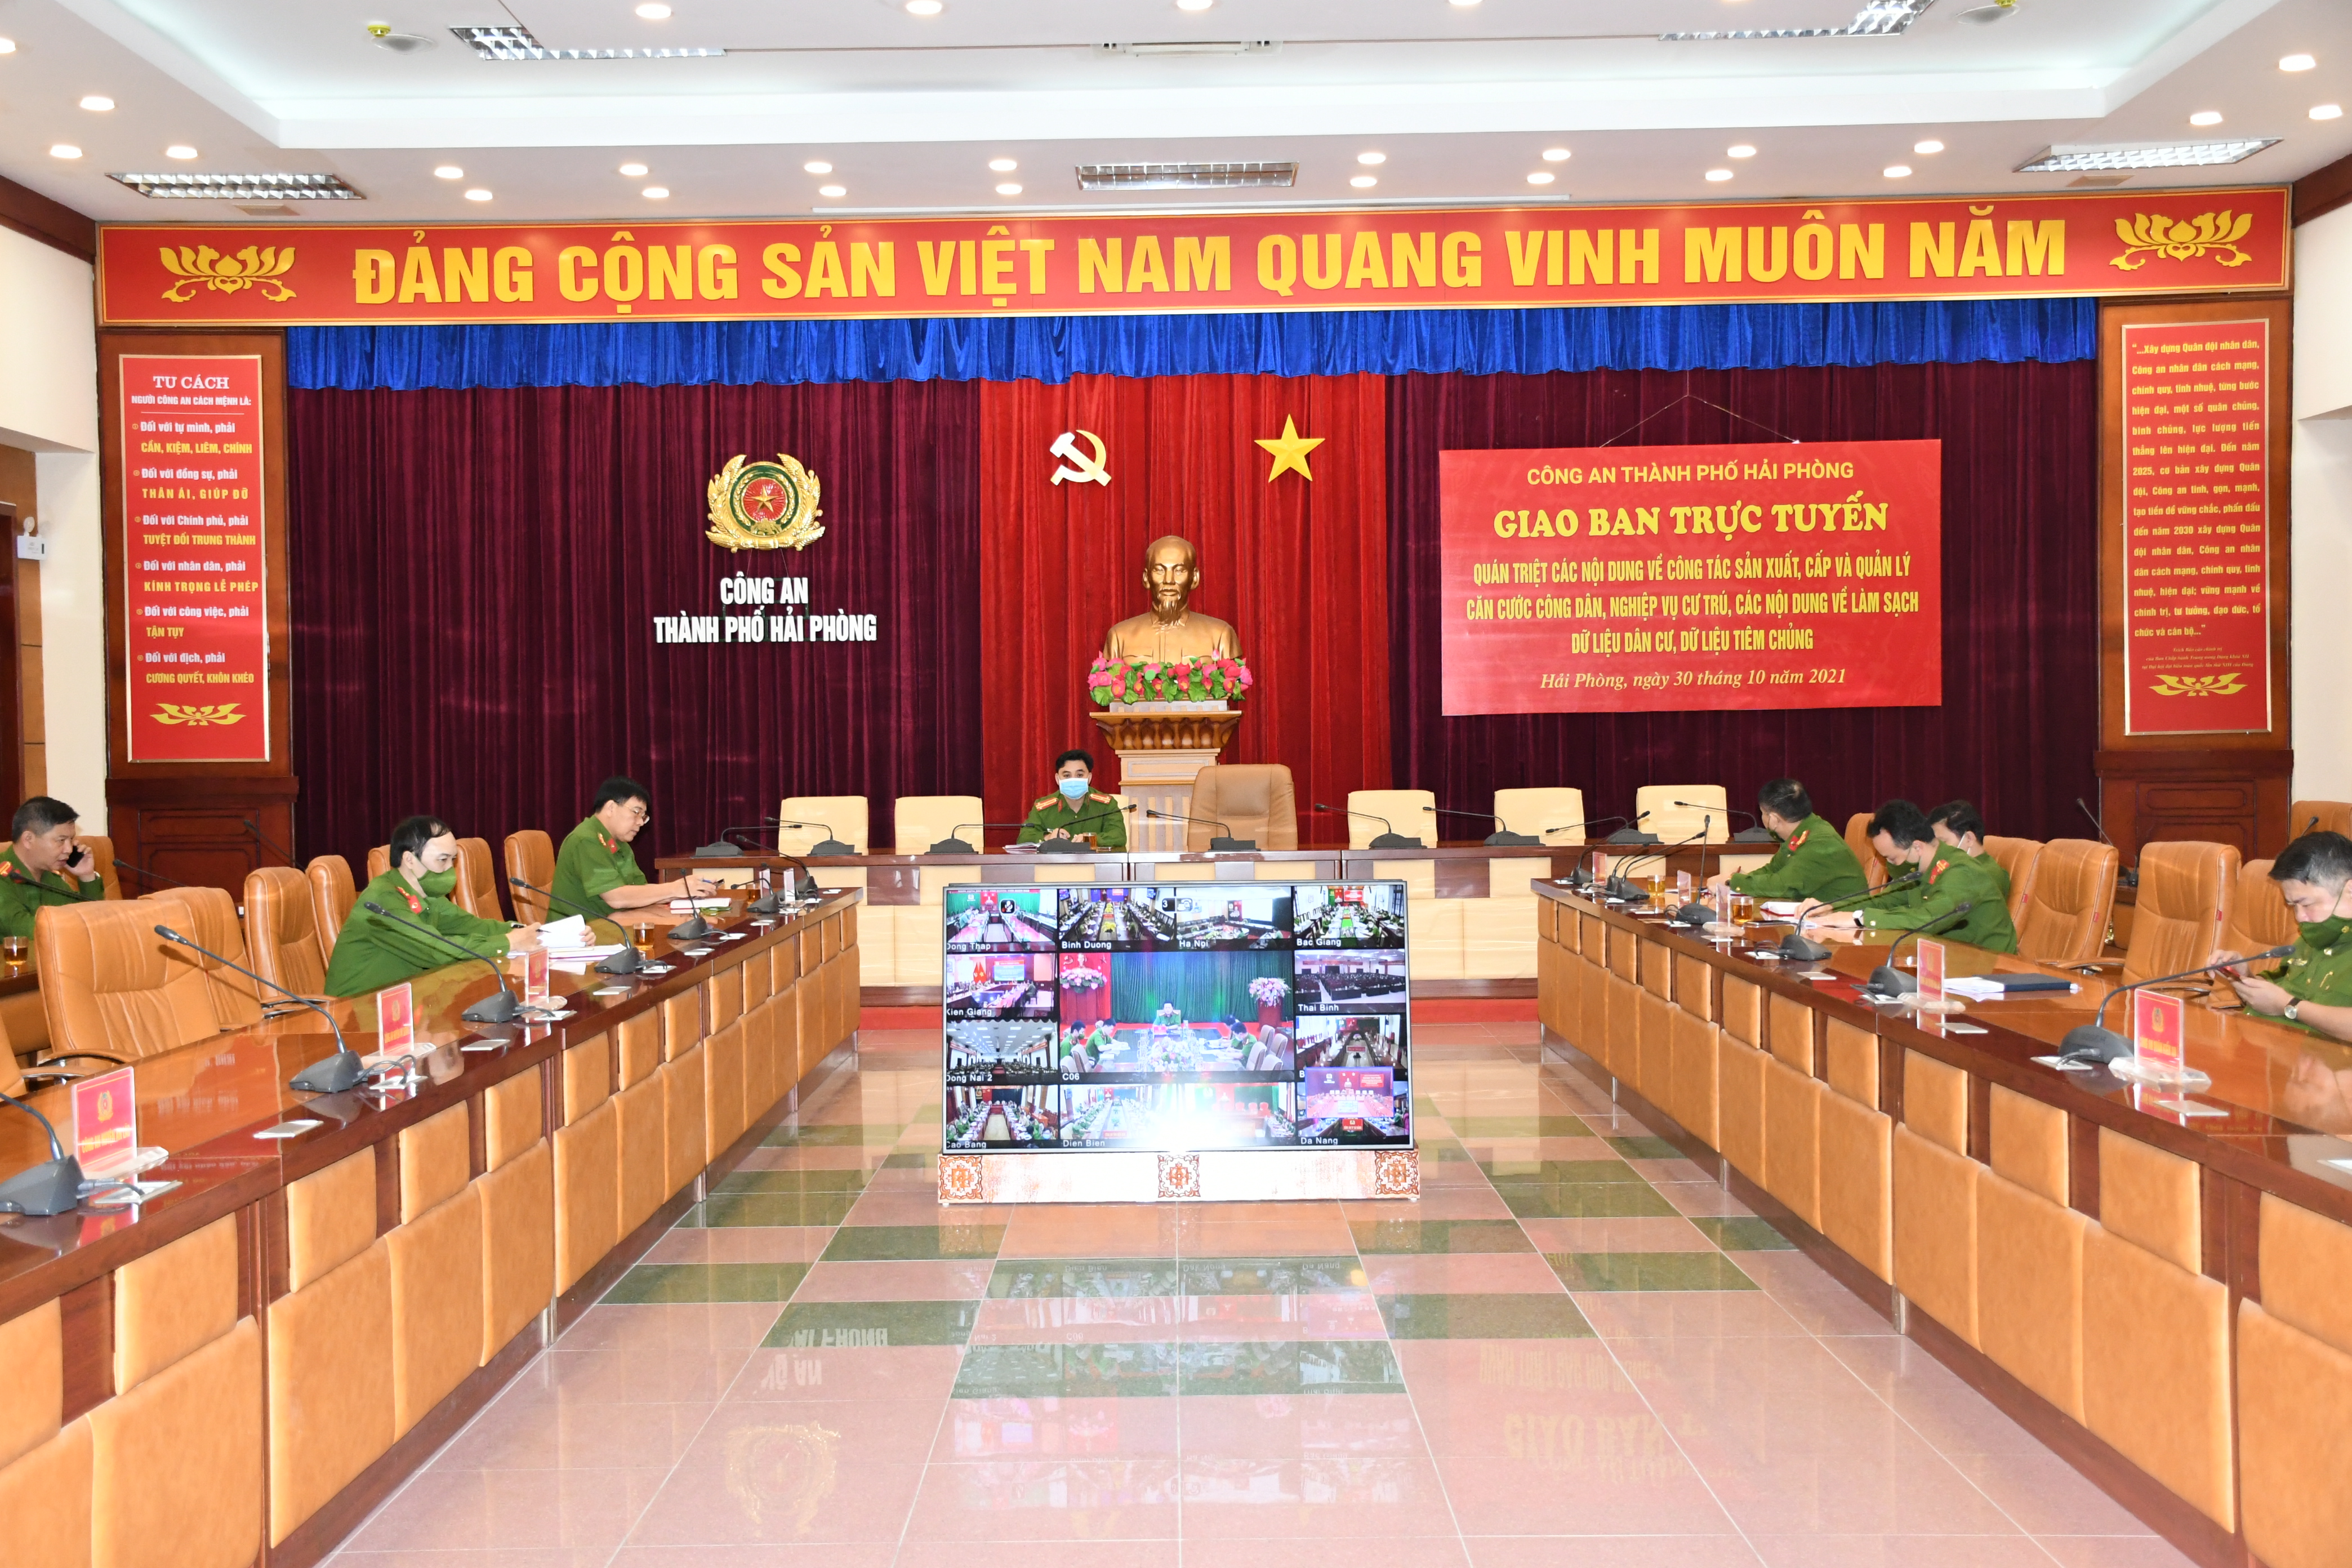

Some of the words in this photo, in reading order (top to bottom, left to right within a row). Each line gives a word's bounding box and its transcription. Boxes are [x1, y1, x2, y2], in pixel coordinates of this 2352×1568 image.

[353, 230, 533, 304] ĐẢNG
[559, 231, 737, 314] CỘNG
[762, 223, 895, 299] SẢN
[917, 226, 1054, 308] VIỆT
[1078, 235, 1231, 293] NAM
[1258, 231, 1481, 292] QUANG
[1505, 229, 1659, 286] VINH
[1685, 210, 1884, 282] MUÔN
[1910, 206, 2065, 277] NĂM
[181, 375, 229, 389] CÁCH
[132, 394, 155, 404] NGƯỜI
[157, 395, 178, 404] CÔNG
[193, 396, 213, 405] CÁCH
[215, 396, 238, 407] MỆNH
[239, 396, 251, 406] LÀ:
[140, 421, 156, 431] Đối
[158, 422, 172, 431] với
[175, 423, 184, 434] tự
[186, 422, 212, 433] mình,
[215, 422, 235, 434] phải
[141, 440, 163, 453] CẦN,
[166, 442, 193, 455] KIỆM,
[195, 442, 221, 454] LIÊM,
[223, 442, 252, 453] CHÍNH
[142, 467, 157, 478] Đối
[159, 469, 173, 478] với
[176, 468, 199, 480] đồng
[201, 470, 215, 481] sự,
[217, 469, 237, 480] phải
[1527, 465, 1582, 484] CÔNG
[1588, 467, 1615, 483] AN
[1621, 462, 1690, 482] THÀNH
[1697, 460, 1738, 480] PHỐ
[1744, 459, 1777, 479] HẢI
[1784, 459, 1853, 479] PHÒNG
[142, 487, 173, 498] THÂN
[200, 487, 228, 499] GIÚP
[143, 514, 158, 524] Đối
[161, 515, 175, 525] với
[177, 515, 203, 525] Chính
[206, 515, 226, 526] phủ,
[229, 515, 248, 527] phải
[1494, 509, 1578, 538] GIAO
[1588, 507, 1660, 536] BAN
[1670, 500, 1762, 541] TRỰC
[1771, 489, 1888, 532] TUYẾN
[144, 533, 171, 546] TUYỆT
[173, 532, 189, 545] ĐỐI
[192, 535, 222, 545] TRUNG
[225, 533, 256, 545] THÀNH
[1474, 559, 1509, 586] QUÁN
[1513, 558, 1548, 587] TRIỆT
[1552, 558, 1577, 582] CÁC
[1582, 557, 1603, 586] NỘI
[1608, 560, 1643, 581] DUNG
[1647, 554, 1663, 580] VỀ
[1667, 555, 1703, 580] CÔNG
[1707, 555, 1731, 579] TÁC
[1735, 552, 1762, 578] SẢN
[1766, 551, 1801, 580] XUẤT,
[1806, 551, 1831, 577] CẤP
[1836, 553, 1852, 577] VÀ
[1856, 550, 1891, 579] QUẢN
[1896, 551, 1910, 576] LÝ
[144, 580, 171, 591] KÍNH
[175, 582, 211, 594] TRỌNG
[214, 579, 226, 591] LỄ
[230, 580, 258, 591] PHÉP
[720, 571, 774, 604] CÔNG
[780, 577, 808, 604] AN
[1466, 595, 1493, 620] CĂN
[1498, 594, 1531, 620] CƯỚC
[1536, 594, 1571, 618] CÔNG
[1575, 593, 1606, 620] DÂN,
[1610, 592, 1658, 621] NGHIỆP
[1661, 596, 1678, 620] VỤ
[1682, 593, 1700, 616] CƯ
[1703, 590, 1731, 617] TRÚ,
[1736, 590, 1761, 614] CÁC
[1766, 589, 1788, 618] NỘI
[1793, 593, 1828, 613] DUNG
[1832, 586, 1847, 613] VỀ
[1852, 589, 1879, 612] LÀM
[1884, 592, 1918, 617] SẠCH
[654, 611, 719, 643] THÀNH
[725, 606, 764, 642] PHỐ
[770, 606, 804, 642] HẢI
[810, 609, 876, 642] PHÒNG
[1572, 629, 1590, 653] DỮ
[1593, 629, 1620, 657] LIỆU
[1625, 628, 1651, 652] DÂN
[1656, 630, 1676, 654] CƯ,
[1681, 627, 1699, 651] DỮ
[1702, 626, 1729, 655] LIỆU
[1733, 626, 1765, 650] TIÊM
[1769, 622, 1813, 650] CHỦNG
[1540, 673, 1570, 688] Hải
[1574, 673, 1627, 691] Phòng,
[1633, 672, 1669, 689] ngày
[1674, 671, 1692, 685] 30
[1698, 670, 1742, 688] tháng
[1748, 670, 1765, 684] 10
[1770, 670, 1803, 684] năm
[1809, 669, 1845, 683] 2021
[970, 942, 991, 951] Thap
[1062, 941, 1081, 949] Binh
[1084, 940, 1112, 950] Duong
[1316, 938, 1342, 947] Giang
[966, 1008, 992, 1017] Giang
[970, 1073, 984, 1082] Nai
[987, 1073, 992, 1082] 2
[1062, 1072, 1080, 1081] C06
[965, 1140, 986, 1150] Bang
[1316, 1137, 1338, 1146] Nang
